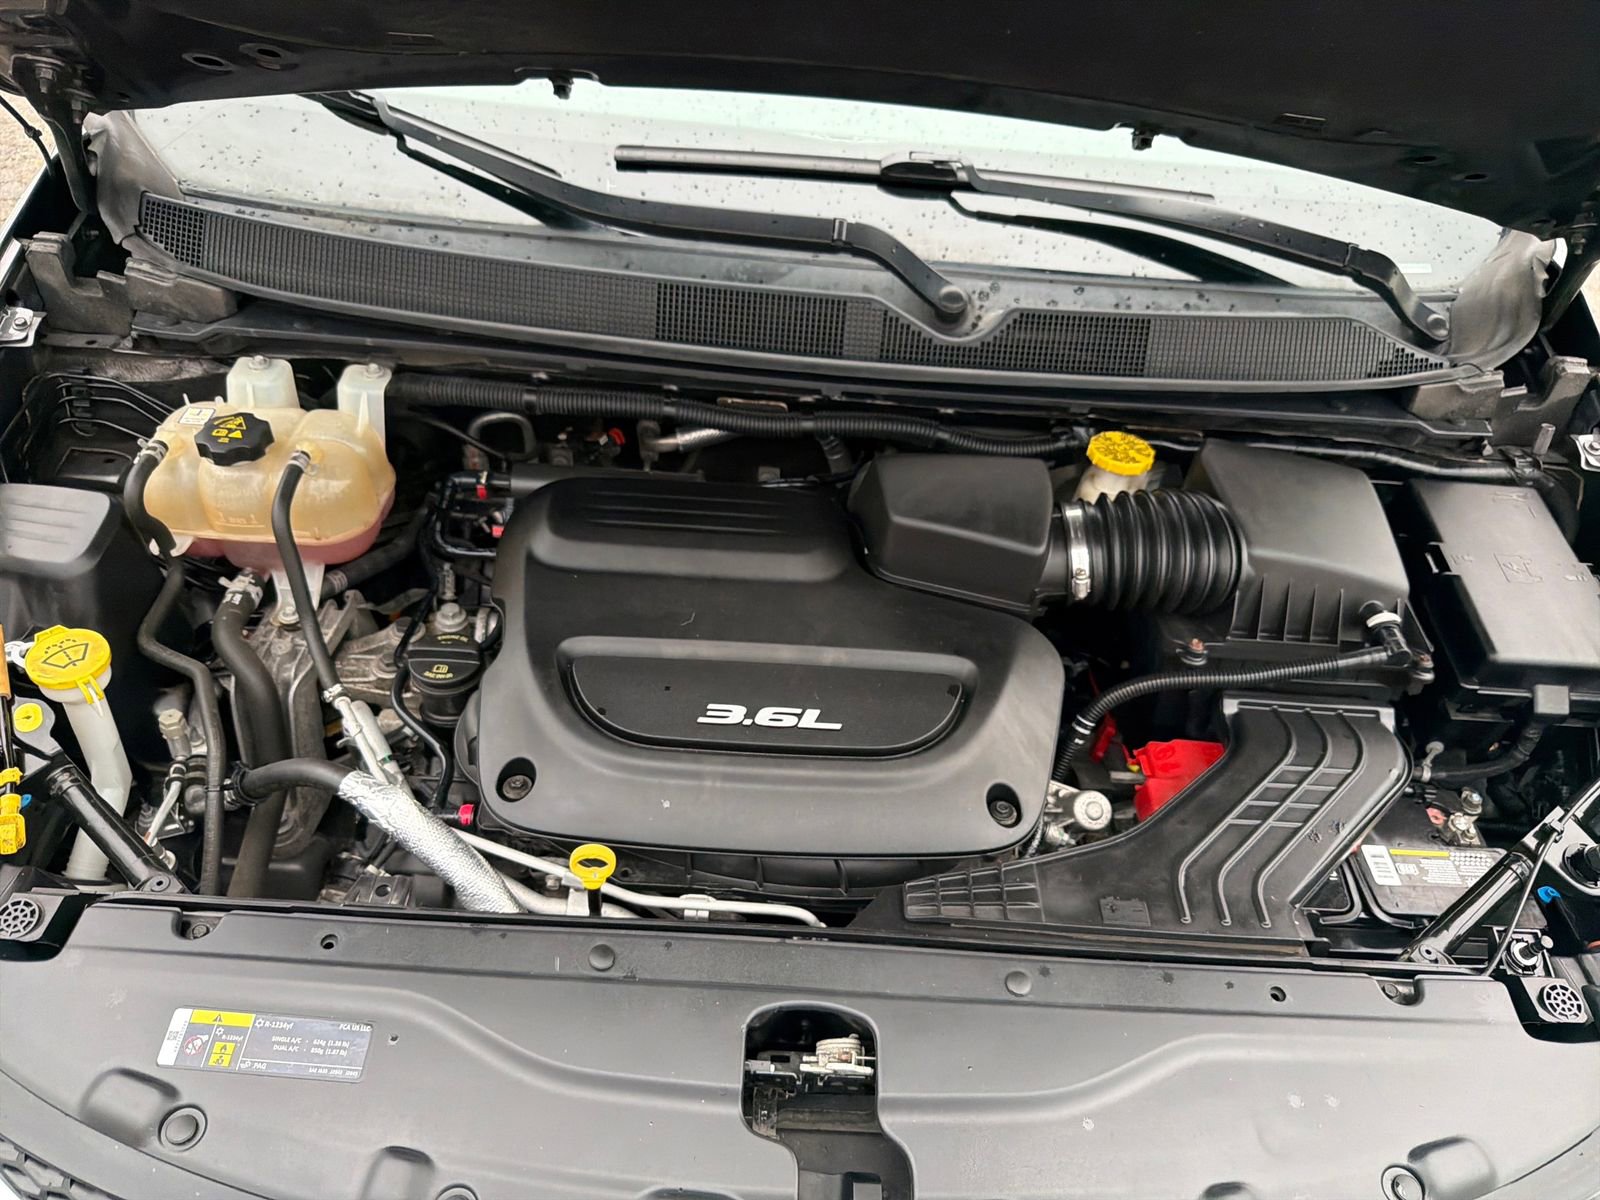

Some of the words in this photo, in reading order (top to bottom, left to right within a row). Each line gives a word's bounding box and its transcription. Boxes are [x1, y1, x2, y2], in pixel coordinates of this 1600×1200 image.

[697, 703, 843, 730] 3.6L
[339, 1023, 351, 1031] FCA
[360, 1024, 372, 1032] LLC
